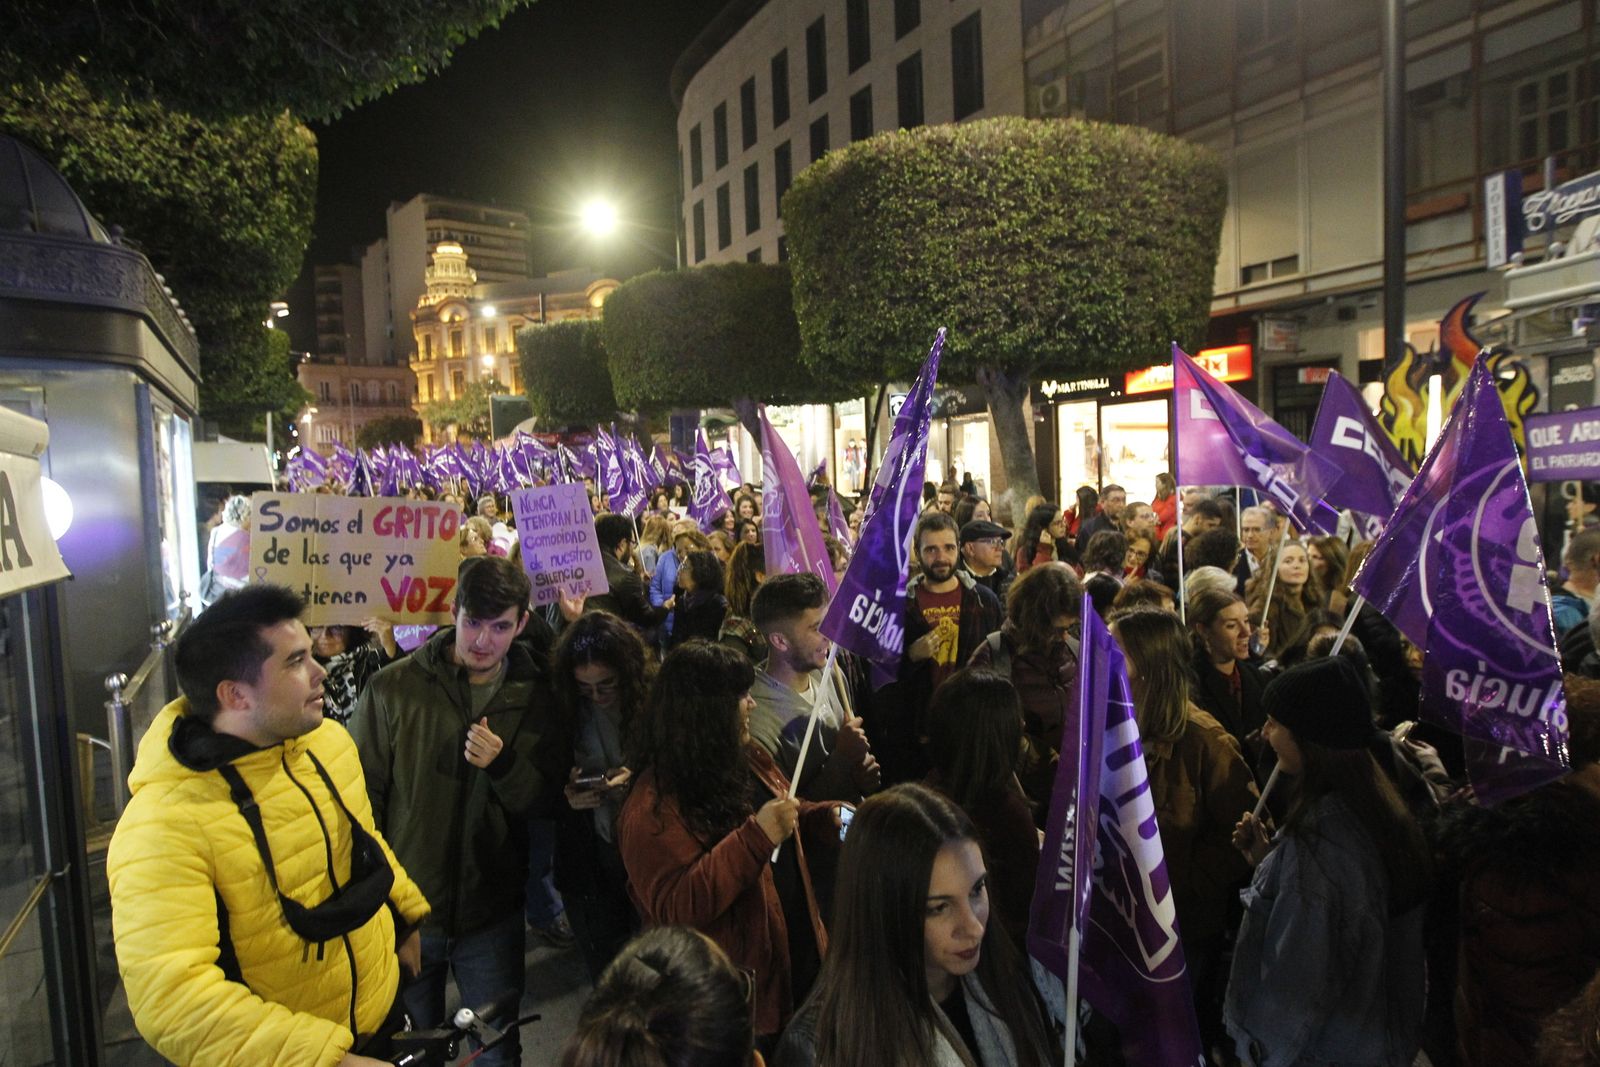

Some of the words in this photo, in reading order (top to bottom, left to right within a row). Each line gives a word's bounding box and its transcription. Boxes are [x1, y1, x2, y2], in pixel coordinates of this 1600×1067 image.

[1529, 425, 1564, 448] QUE
[1532, 456, 1547, 470] EL
[259, 500, 340, 534] Somos
[347, 509, 363, 534] el
[373, 505, 459, 541] GRITO
[574, 508, 588, 524] LA
[263, 537, 290, 565] de
[302, 538, 330, 565] las
[339, 552, 372, 575] que
[385, 553, 414, 574] ya
[301, 582, 367, 606] tienen
[380, 575, 456, 613] VOZ
